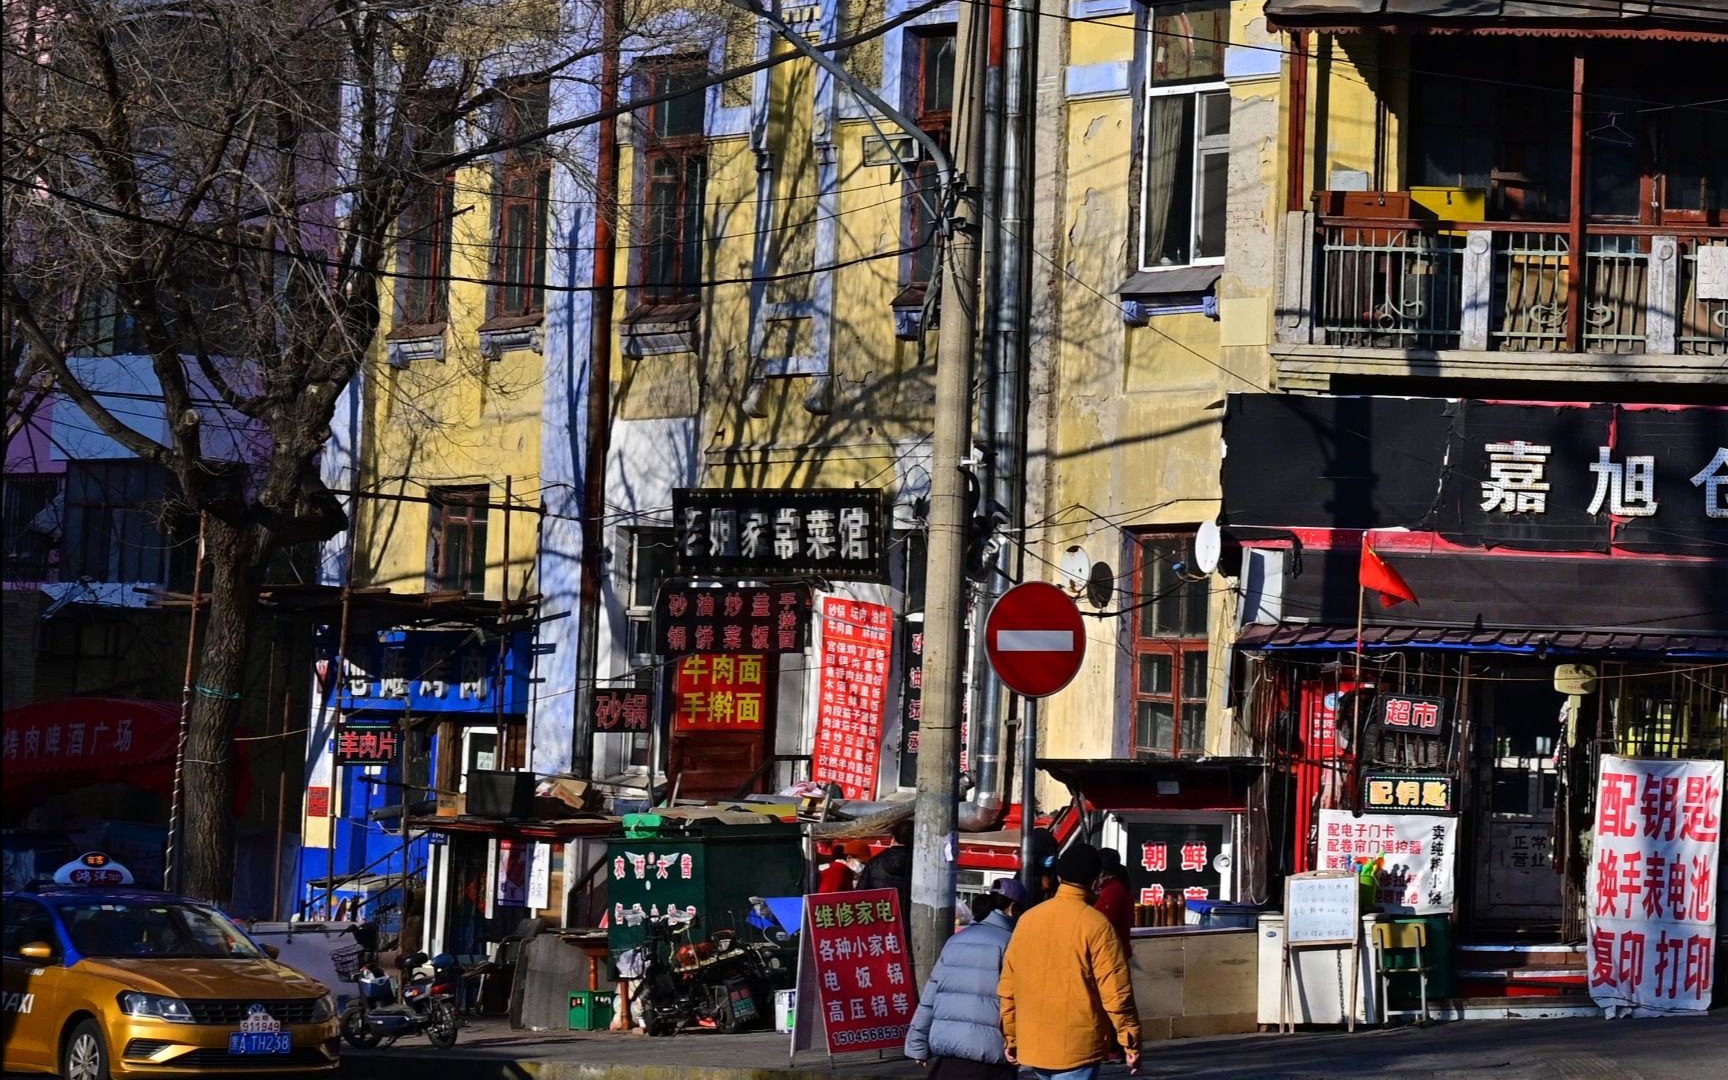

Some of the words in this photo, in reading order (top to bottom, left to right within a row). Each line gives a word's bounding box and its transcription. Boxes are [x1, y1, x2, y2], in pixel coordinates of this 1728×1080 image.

[682, 654, 763, 685] 牛肉面
[595, 693, 648, 729] 砂锅
[680, 691, 762, 724] 手擀面
[1384, 699, 1438, 728] 超市
[340, 731, 396, 759] 羊肉片
[1369, 781, 1447, 806] 配钥匙
[1598, 772, 1719, 842] 配钥匙
[1327, 823, 1395, 838] 配电子门卡
[1512, 835, 1546, 850] 正常
[1141, 841, 1207, 872] 朝鲜
[1327, 839, 1422, 855] 配卷帘门遥控器
[1596, 848, 1710, 921] 换手表电池
[814, 899, 896, 929] 维修家电
[819, 933, 901, 962] 各种小家电
[824, 963, 904, 991] 电饭锅
[1591, 927, 1645, 993] 复印
[1655, 930, 1711, 1001] 打印
[827, 992, 909, 1022] 高压锅等
